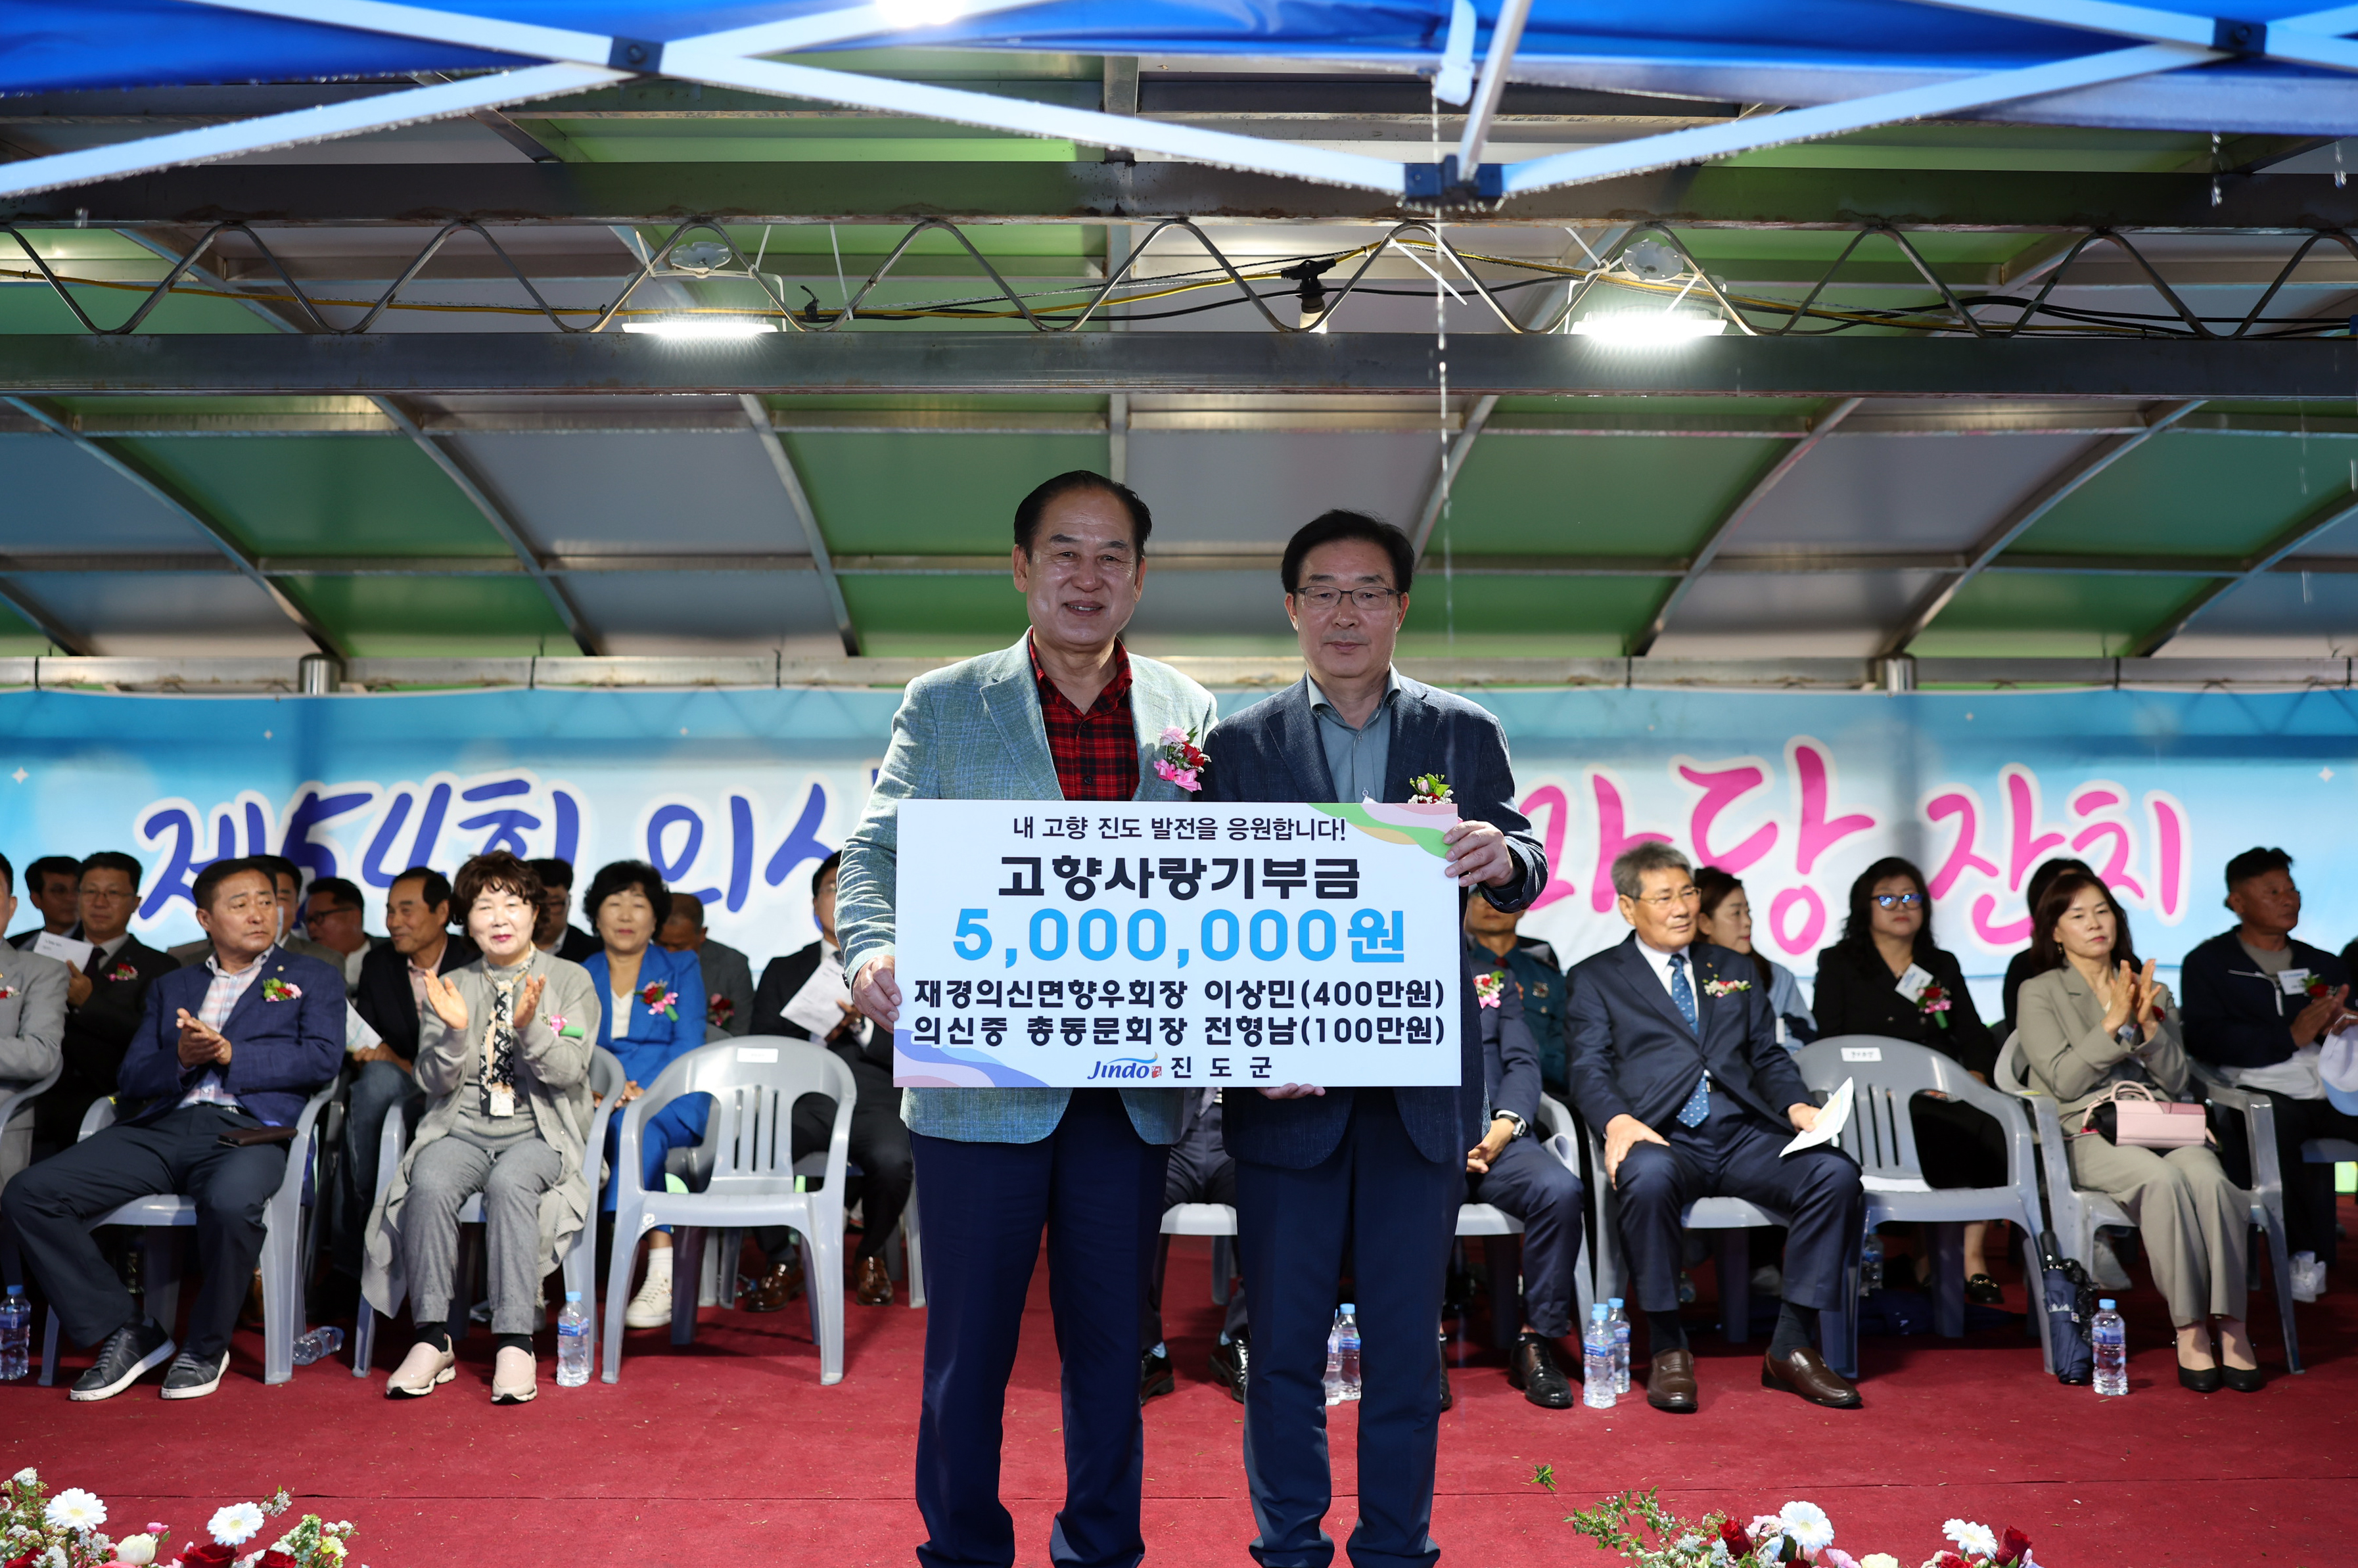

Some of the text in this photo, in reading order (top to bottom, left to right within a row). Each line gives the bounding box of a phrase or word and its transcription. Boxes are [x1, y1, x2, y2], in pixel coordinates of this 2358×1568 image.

[1013, 816, 1346, 841] 내 고향 진도 발전을 응원합니다!
[1926, 773, 2180, 945] 잔치
[998, 855, 1360, 902] 고향사랑기부금
[953, 908, 1404, 969] 5,000,000원
[914, 979, 1444, 1011] 재경의신면향우회장 이상민(400만원)
[913, 1015, 1445, 1048] 의신중 총동문회장 전형남(100만원)
[1087, 1060, 1149, 1080] Jindo
